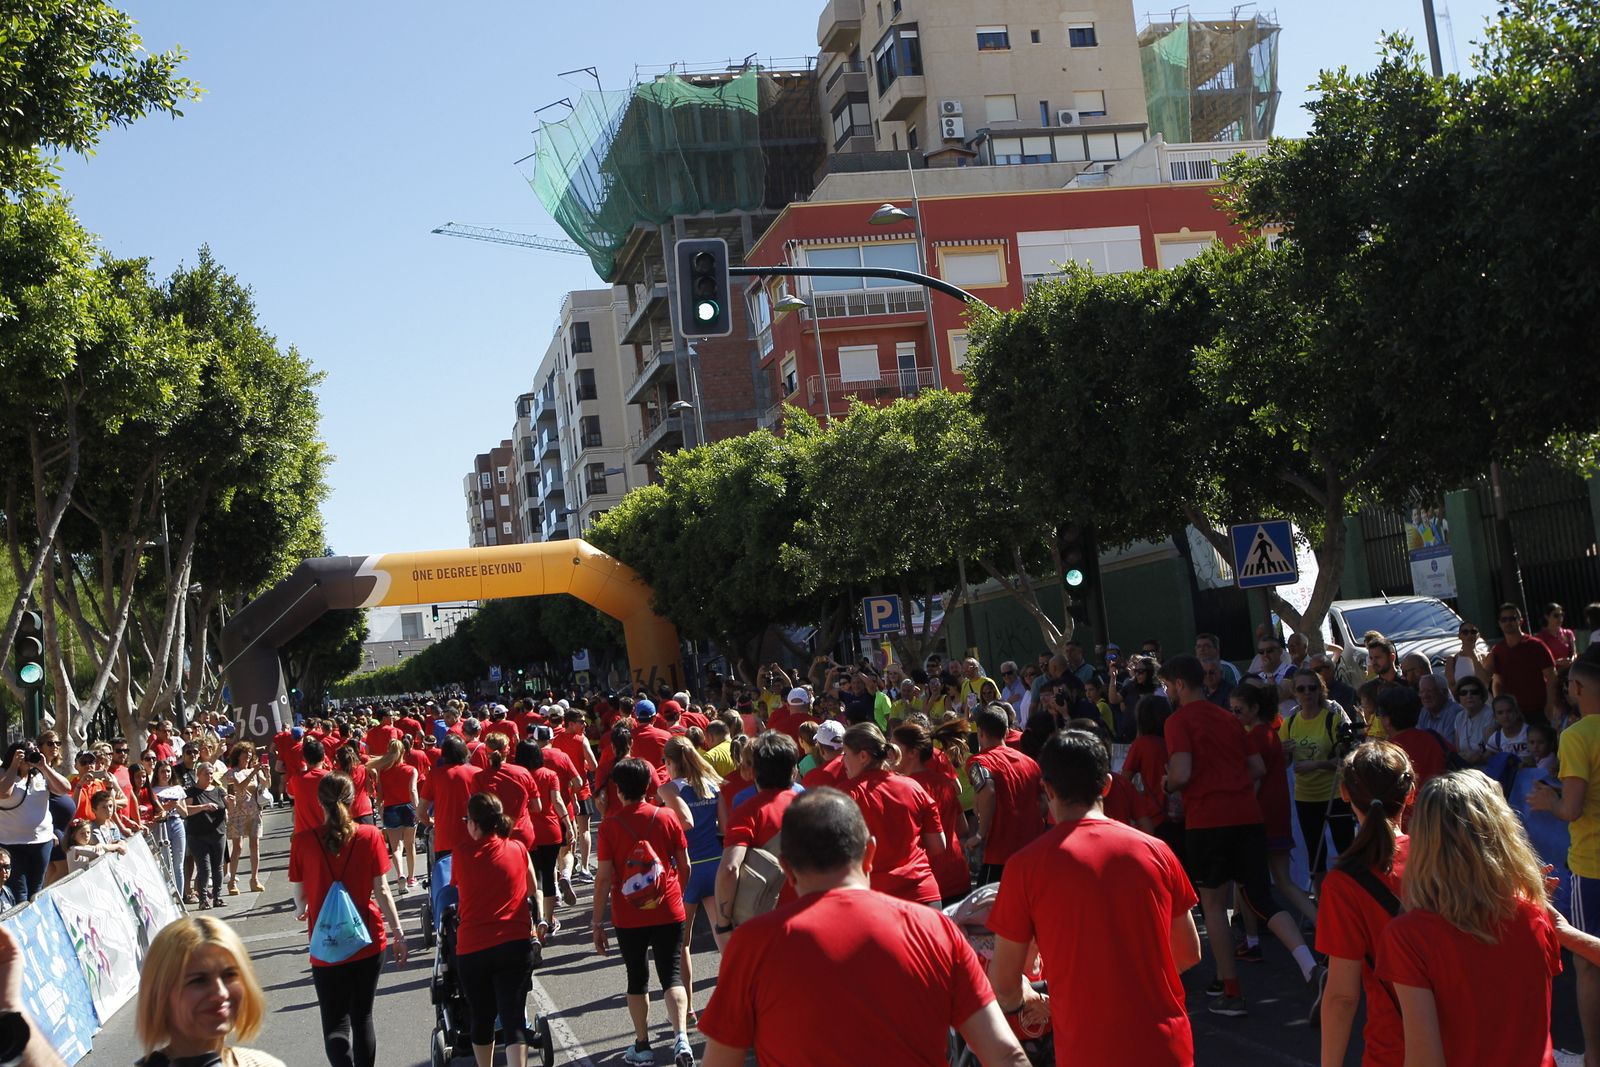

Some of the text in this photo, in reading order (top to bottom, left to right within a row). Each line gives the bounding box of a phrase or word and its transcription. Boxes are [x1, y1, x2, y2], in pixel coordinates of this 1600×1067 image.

[412, 561, 523, 582] ONE DEGREE BEYOND
[870, 599, 893, 630] P
